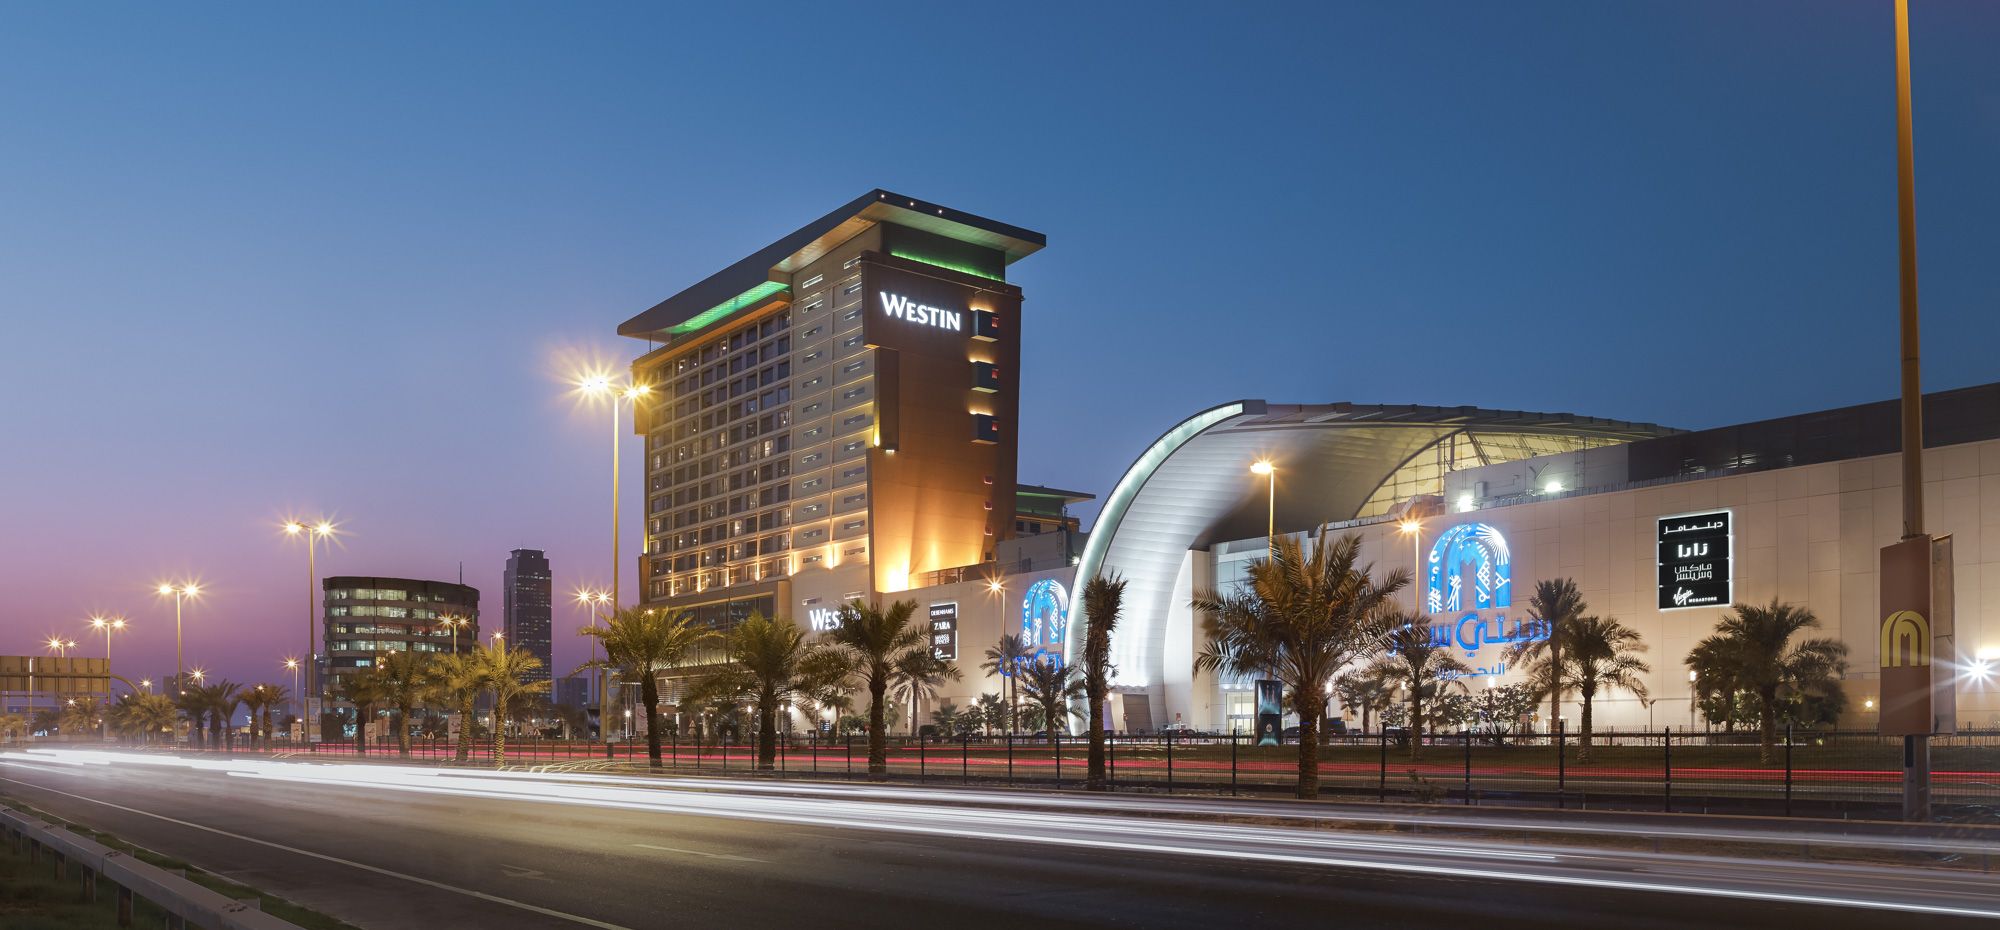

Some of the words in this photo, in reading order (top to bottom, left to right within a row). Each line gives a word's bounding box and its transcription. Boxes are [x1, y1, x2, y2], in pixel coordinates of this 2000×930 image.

[879, 291, 961, 332] WESTIN
[1678, 542, 1709, 558] زارا
[934, 621, 951, 631] ZARA
